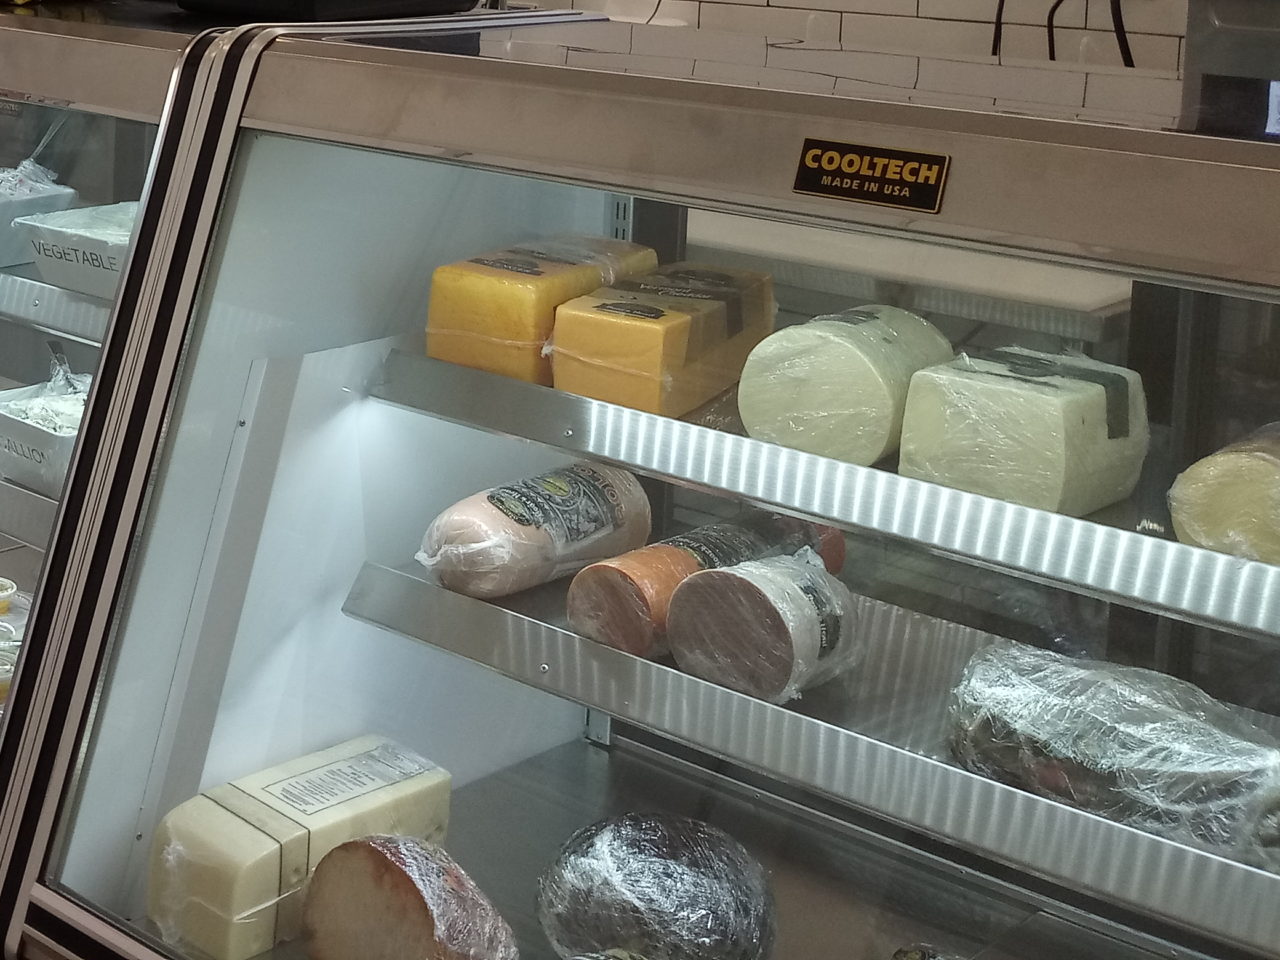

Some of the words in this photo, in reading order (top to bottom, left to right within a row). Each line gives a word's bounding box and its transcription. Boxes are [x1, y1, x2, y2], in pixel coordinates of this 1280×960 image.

[805, 148, 939, 185] COOLTECH
[821, 175, 860, 190] MADE
[864, 182, 879, 192] IN
[884, 184, 910, 197] USA
[32, 240, 119, 272] VEGETABLE
